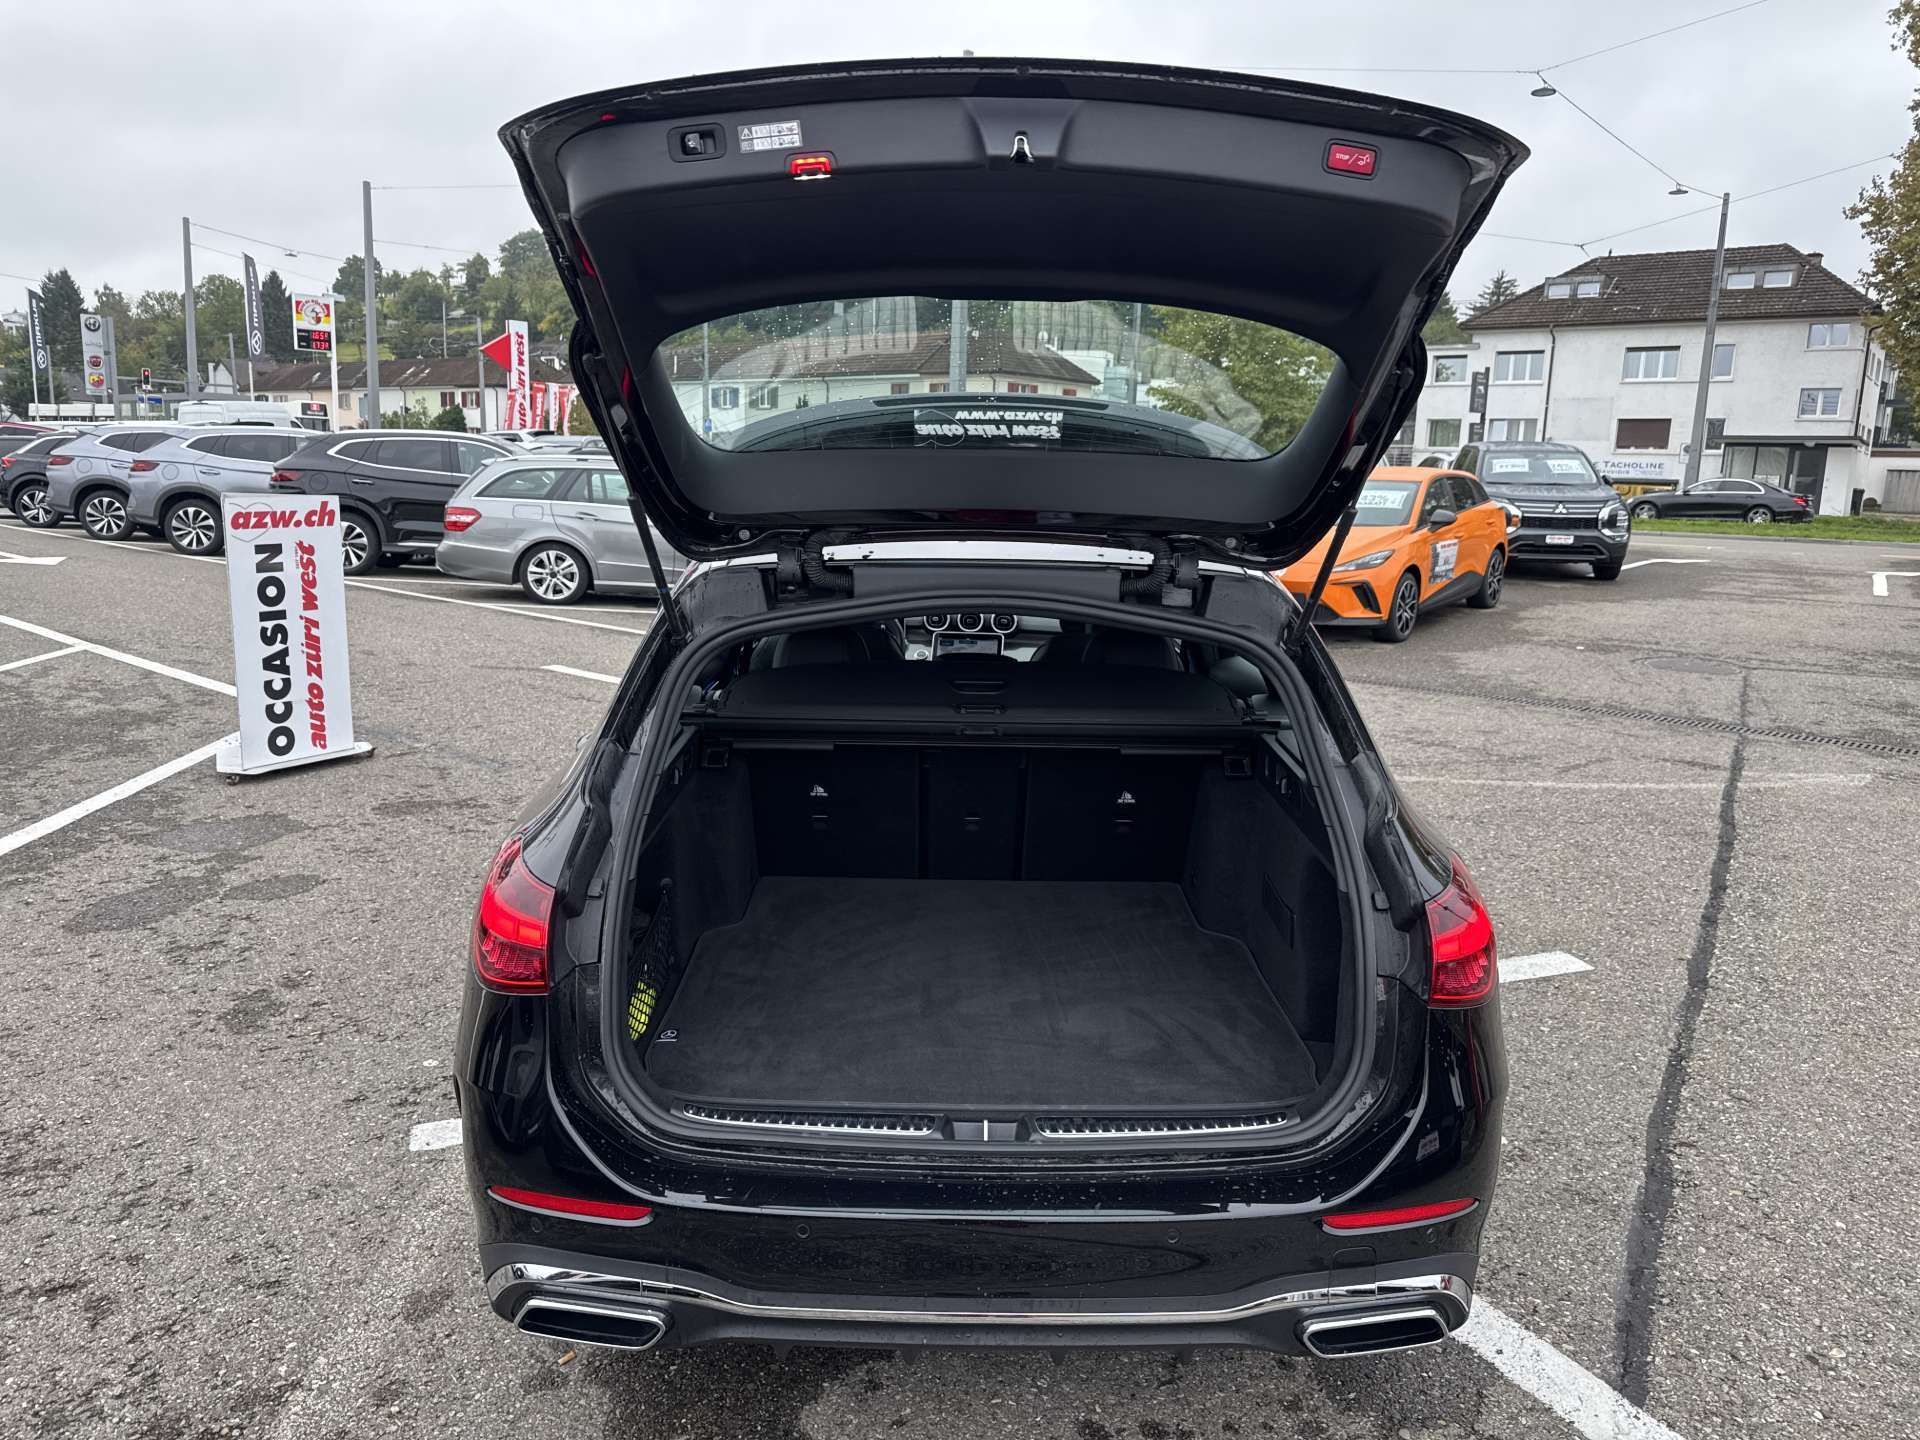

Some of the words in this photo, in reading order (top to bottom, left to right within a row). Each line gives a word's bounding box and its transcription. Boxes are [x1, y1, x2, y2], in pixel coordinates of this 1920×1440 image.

[32, 298, 43, 348] MAXUS
[515, 331, 526, 367] west
[518, 400, 527, 429] uto
[1603, 460, 1665, 470] TACHOLINE
[230, 500, 336, 530] azw.ch
[294, 540, 319, 611] west
[254, 543, 295, 757] OCCASION
[299, 614, 323, 680] züri
[305, 682, 327, 750] auto
